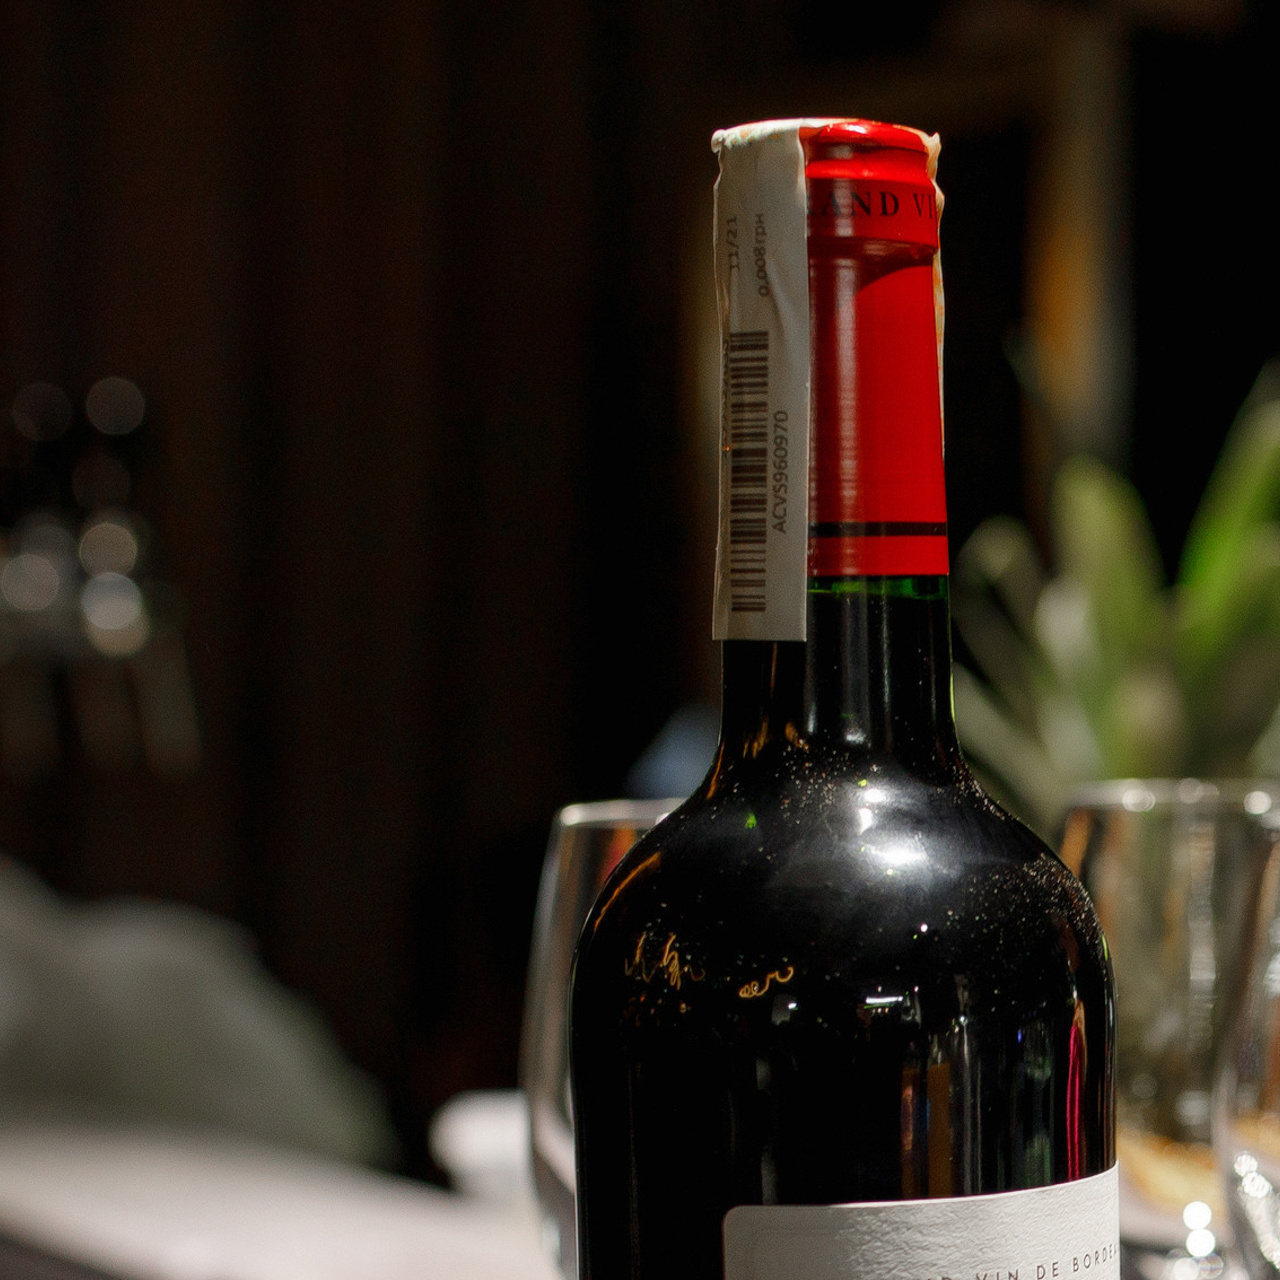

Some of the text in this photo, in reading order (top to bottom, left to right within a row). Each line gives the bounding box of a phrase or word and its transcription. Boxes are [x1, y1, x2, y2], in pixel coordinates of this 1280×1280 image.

[806, 190, 934, 219] AND VI
[1036, 1261, 1059, 1280] DE
